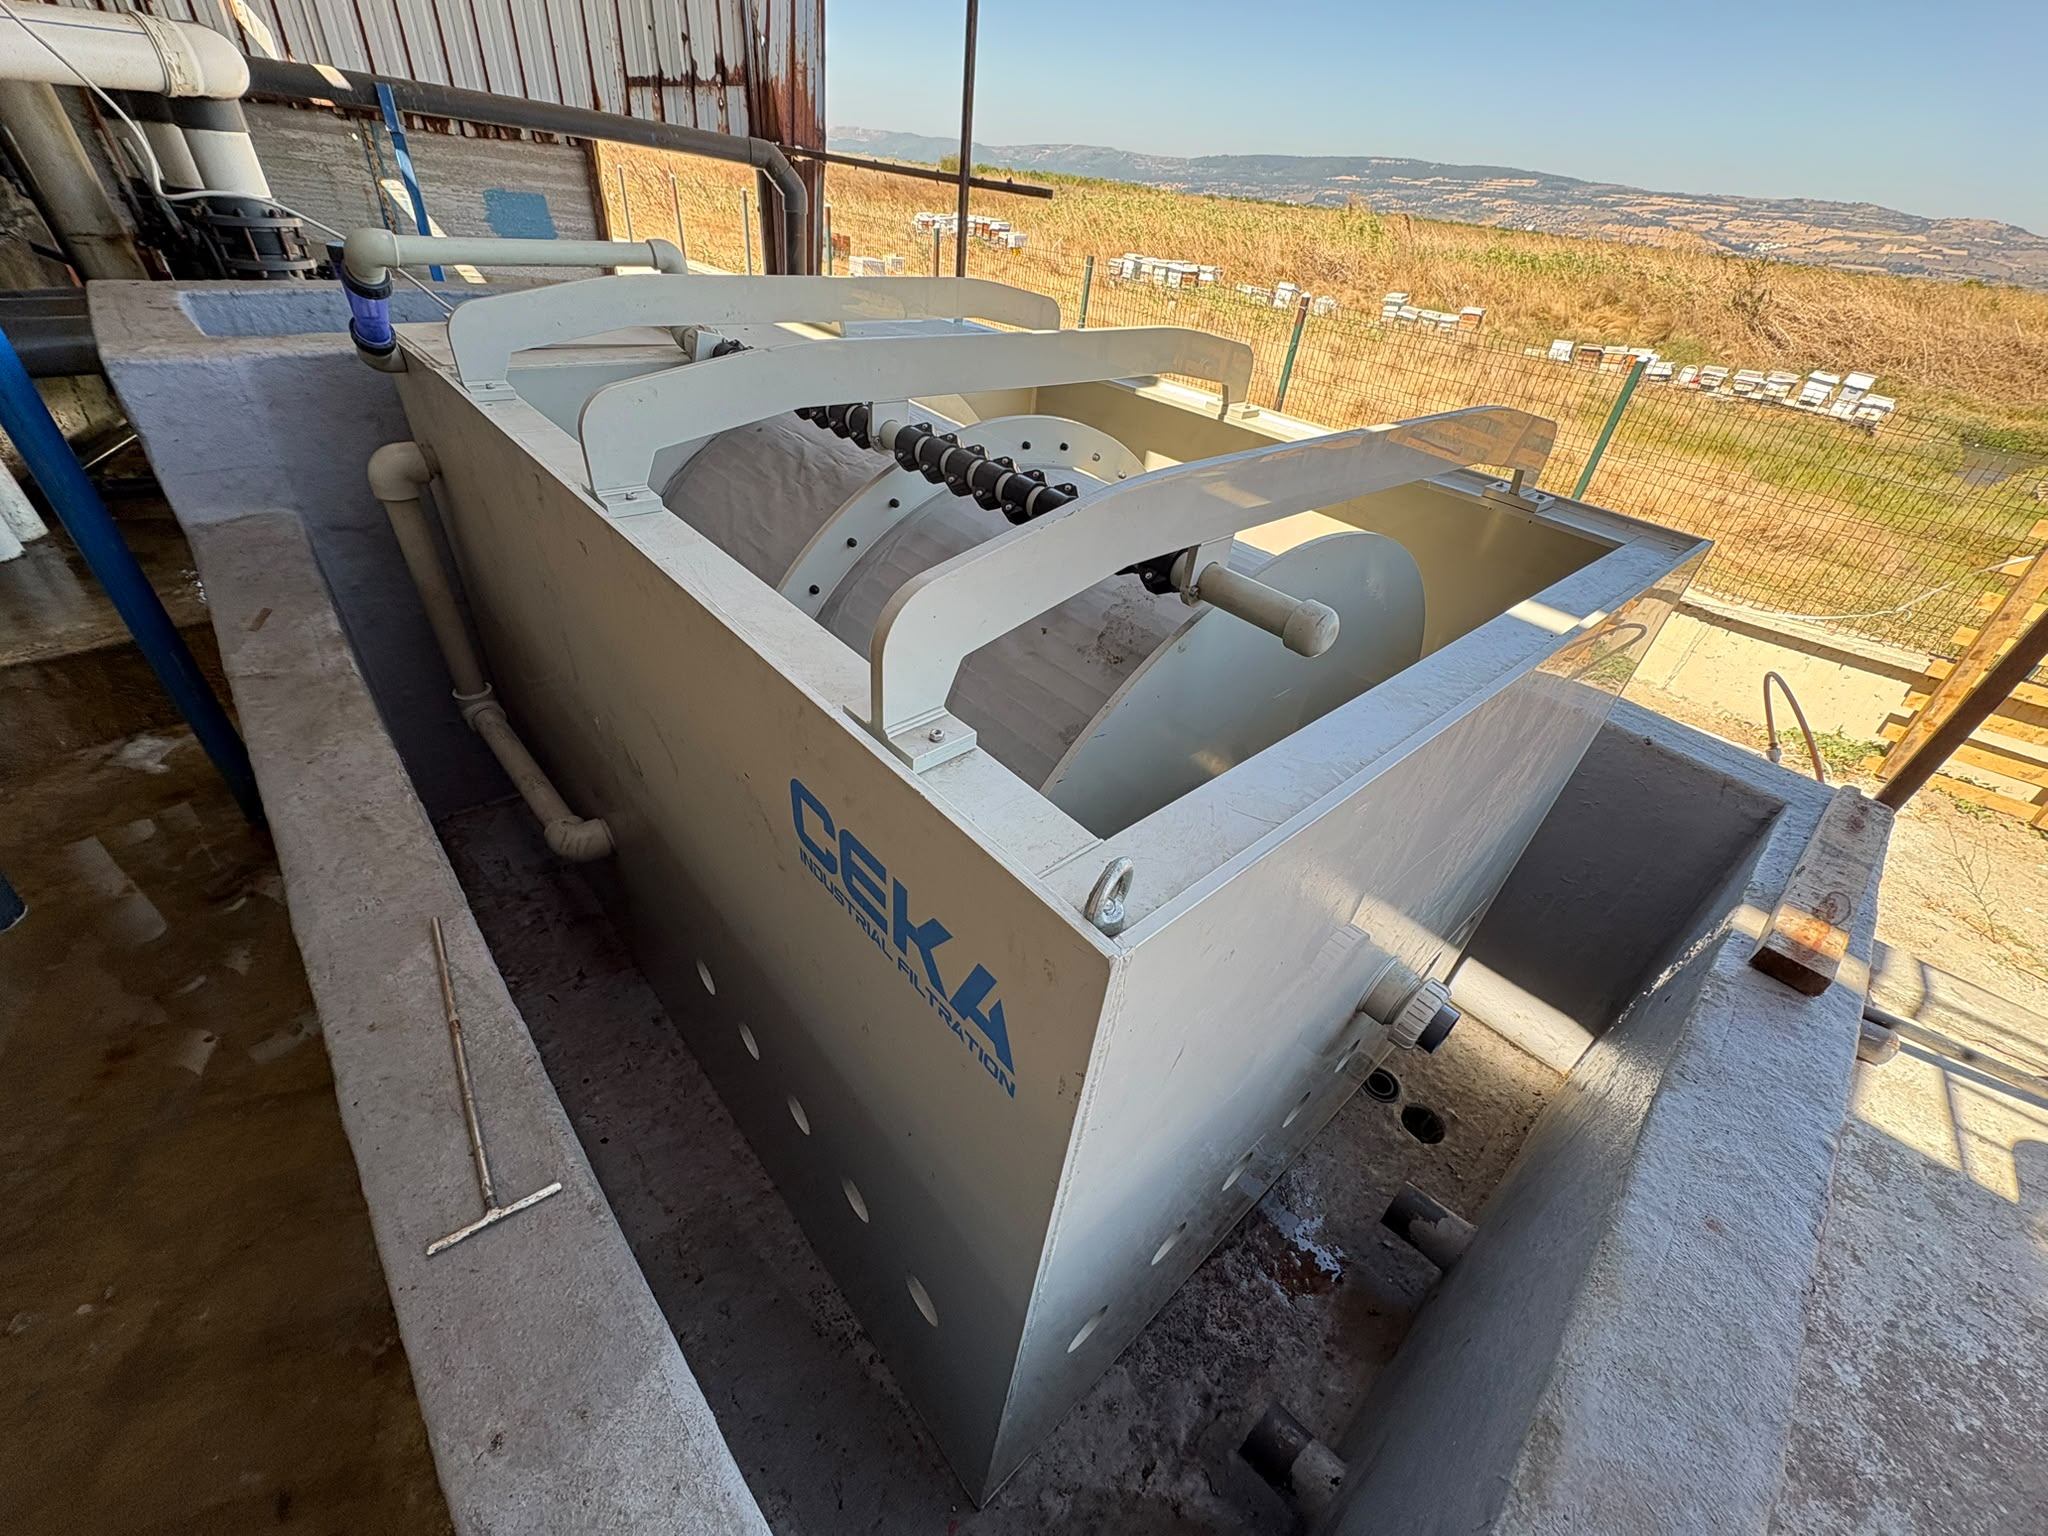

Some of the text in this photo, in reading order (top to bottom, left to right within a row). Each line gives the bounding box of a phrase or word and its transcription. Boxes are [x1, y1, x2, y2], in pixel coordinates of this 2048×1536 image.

[790, 778, 1015, 1076] CEKA
[799, 847, 1016, 1099] INDUSTRIAL FILTRATION
